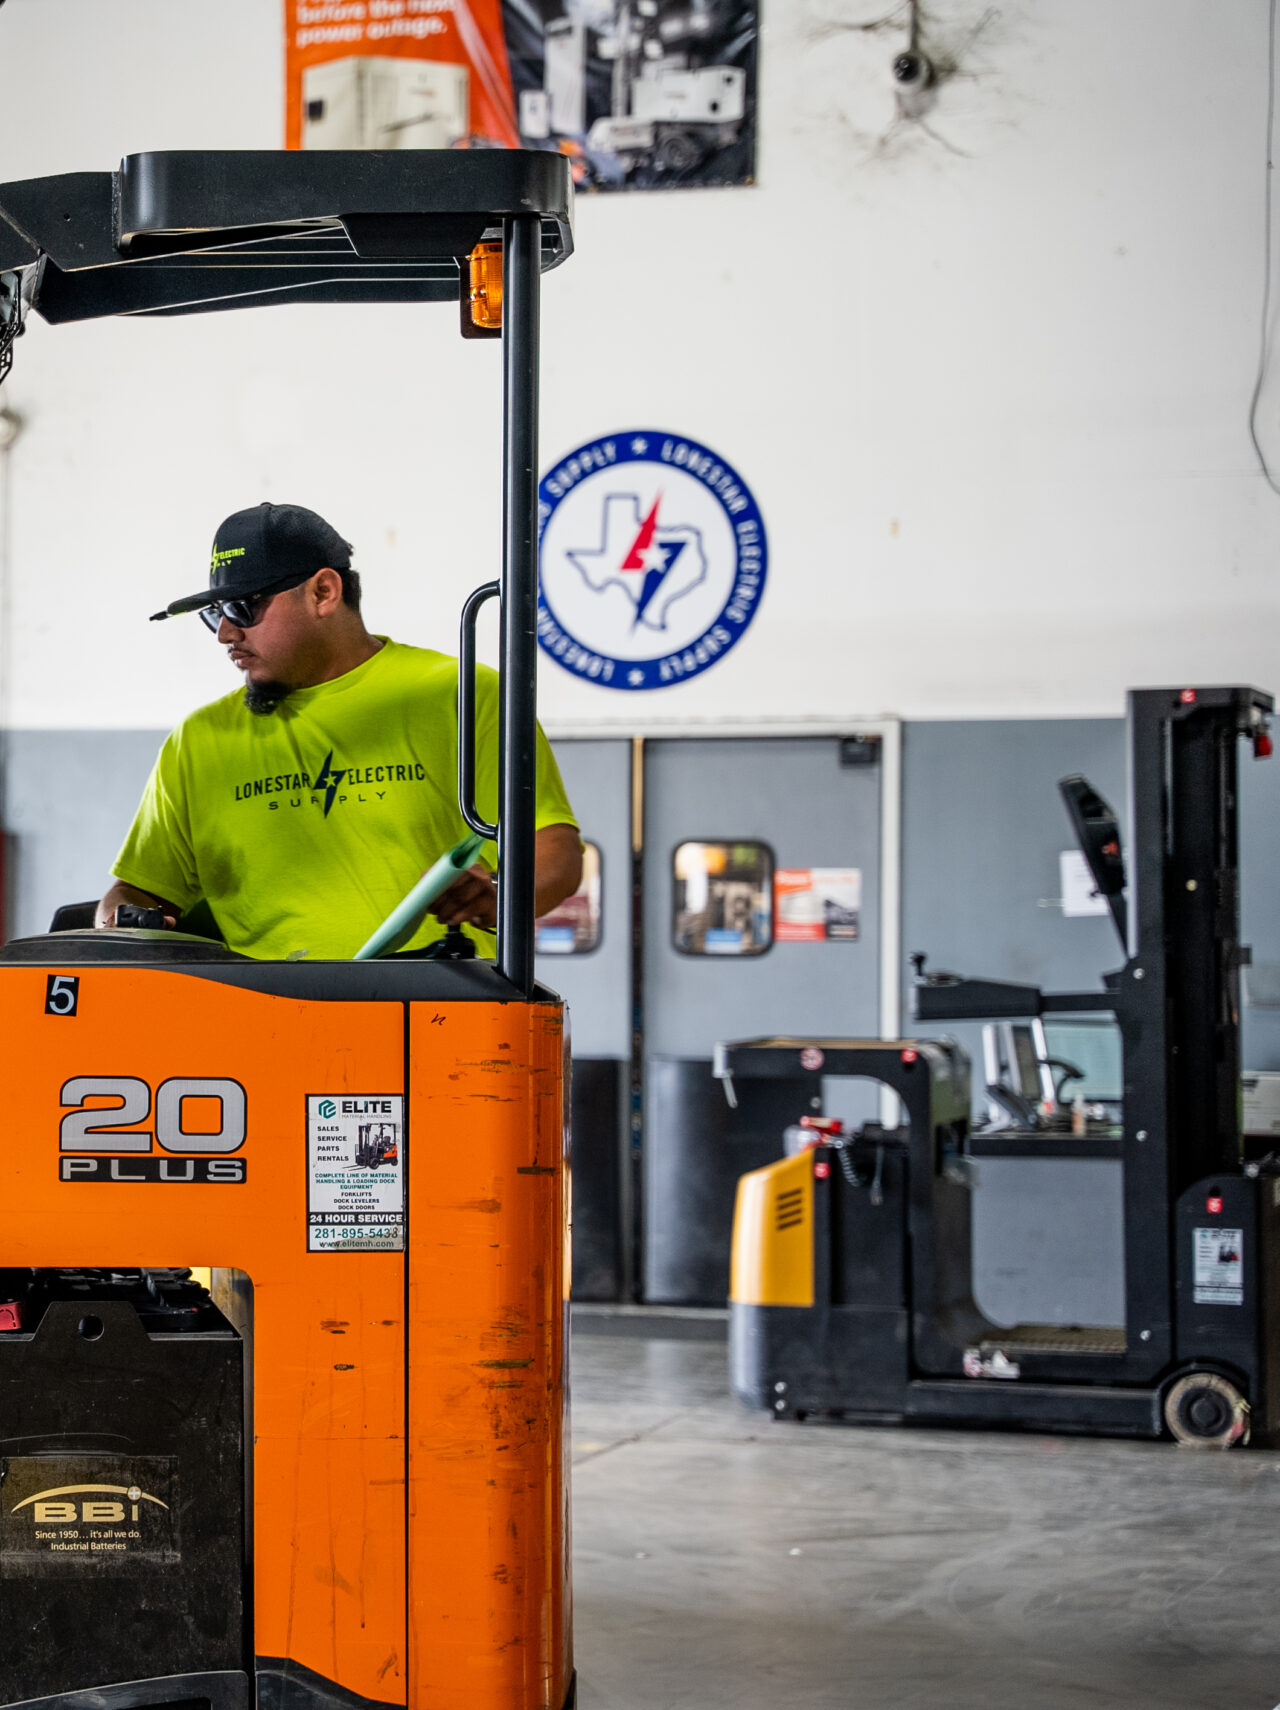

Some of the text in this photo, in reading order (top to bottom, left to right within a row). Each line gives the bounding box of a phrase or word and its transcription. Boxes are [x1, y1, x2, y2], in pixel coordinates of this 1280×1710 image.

[296, 3, 366, 25] before
[369, 0, 405, 19] the
[296, 23, 363, 48] power
[235, 763, 425, 801] LONESTAR ELECTRIC
[49, 975, 75, 1014] 5
[59, 1075, 247, 1154] 20
[342, 1100, 391, 1113] ELITE
[62, 1158, 243, 1182] PLUS
[310, 1214, 402, 1223] 24 HOUR SERVICE
[319, 1240, 394, 1248] www.elitemh.com
[35, 1530, 57, 1539] Since
[90, 1530, 102, 1538] it's
[103, 1530, 113, 1538] all
[128, 1530, 142, 1538] do.
[51, 1541, 126, 1550] Industrial Batteries
